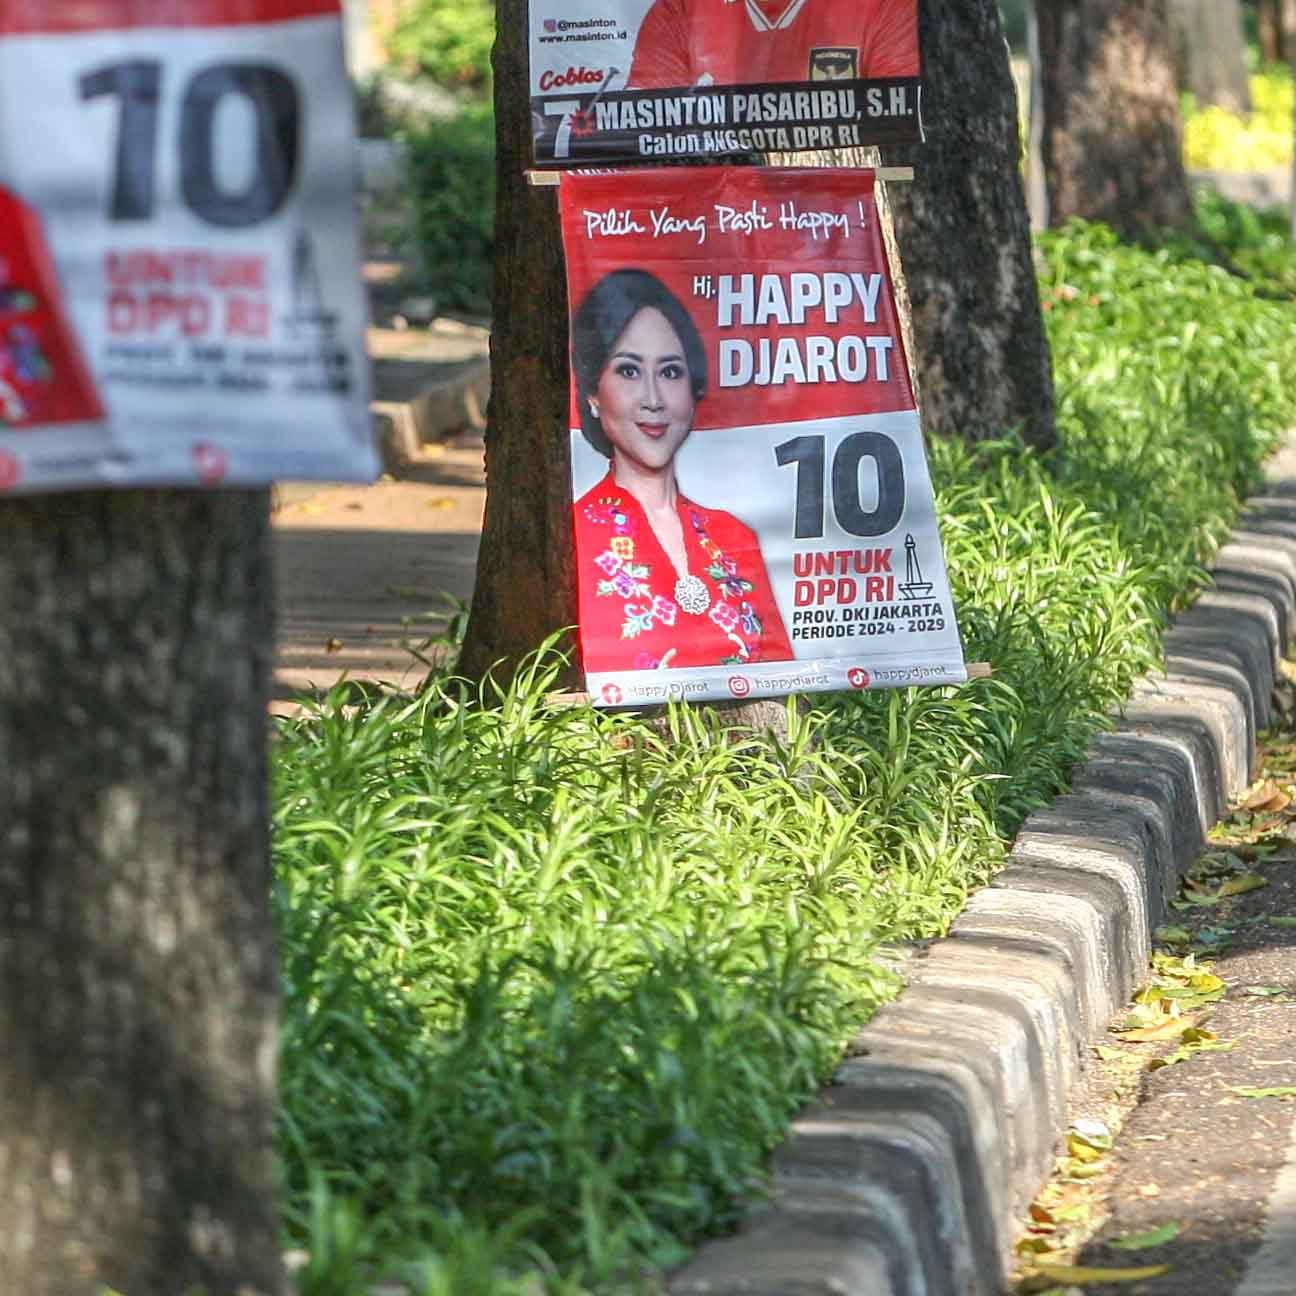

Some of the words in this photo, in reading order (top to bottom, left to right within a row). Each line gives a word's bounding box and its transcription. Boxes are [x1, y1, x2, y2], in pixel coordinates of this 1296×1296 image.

[538, 31, 627, 43] www.masinton.id
[558, 18, 616, 31] @masinton
[544, 100, 581, 158] 7
[596, 95, 726, 130] MASINTON
[732, 89, 862, 123] PASARIBU,
[866, 87, 913, 117] S.H.
[78, 57, 301, 229] 10
[638, 132, 700, 155] Calon
[702, 127, 791, 154] ANGGOTA
[792, 125, 834, 148] DPR
[837, 124, 860, 145] RI
[583, 208, 645, 240] Pilih
[650, 207, 706, 245] Yang
[714, 199, 774, 234] Pasti
[779, 201, 850, 241] Happy
[106, 290, 213, 338] DPD
[693, 275, 716, 299] Hj.
[717, 272, 882, 327] HAPPY
[719, 335, 894, 388] DJAROT
[774, 431, 905, 540] 10
[793, 548, 893, 578] UNTUK
[794, 577, 857, 607] DPD
[865, 575, 895, 603] RI
[792, 625, 855, 640] PERIODE
[858, 622, 895, 636] 2024
[908, 618, 945, 633] 2029
[793, 609, 838, 625] PROV.
[842, 607, 869, 622] DKI
[872, 603, 943, 620] JAKARTA
